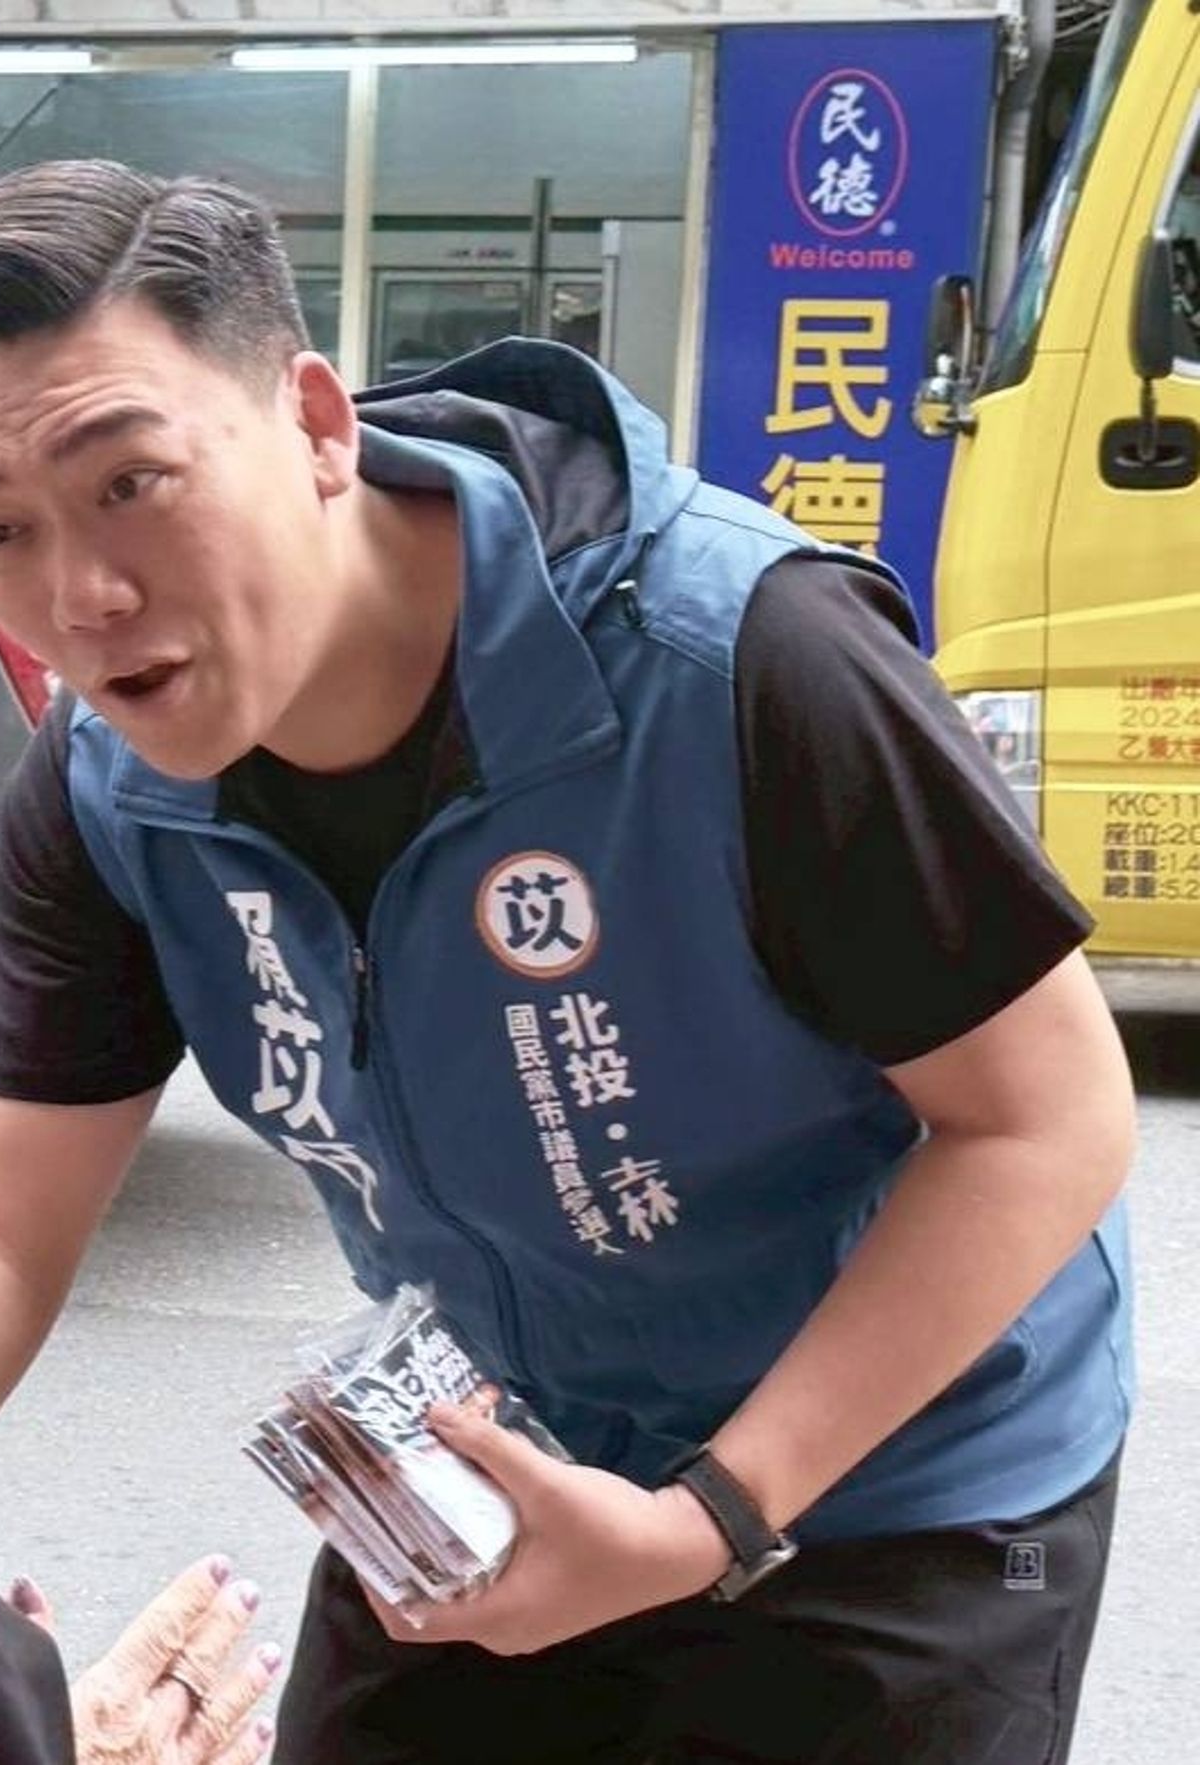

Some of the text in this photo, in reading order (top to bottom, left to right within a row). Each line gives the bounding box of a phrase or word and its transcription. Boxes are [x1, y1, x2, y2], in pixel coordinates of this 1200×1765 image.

[809, 82, 881, 217] 民德
[769, 245, 914, 269] Welcome
[496, 872, 584, 951] 苡
